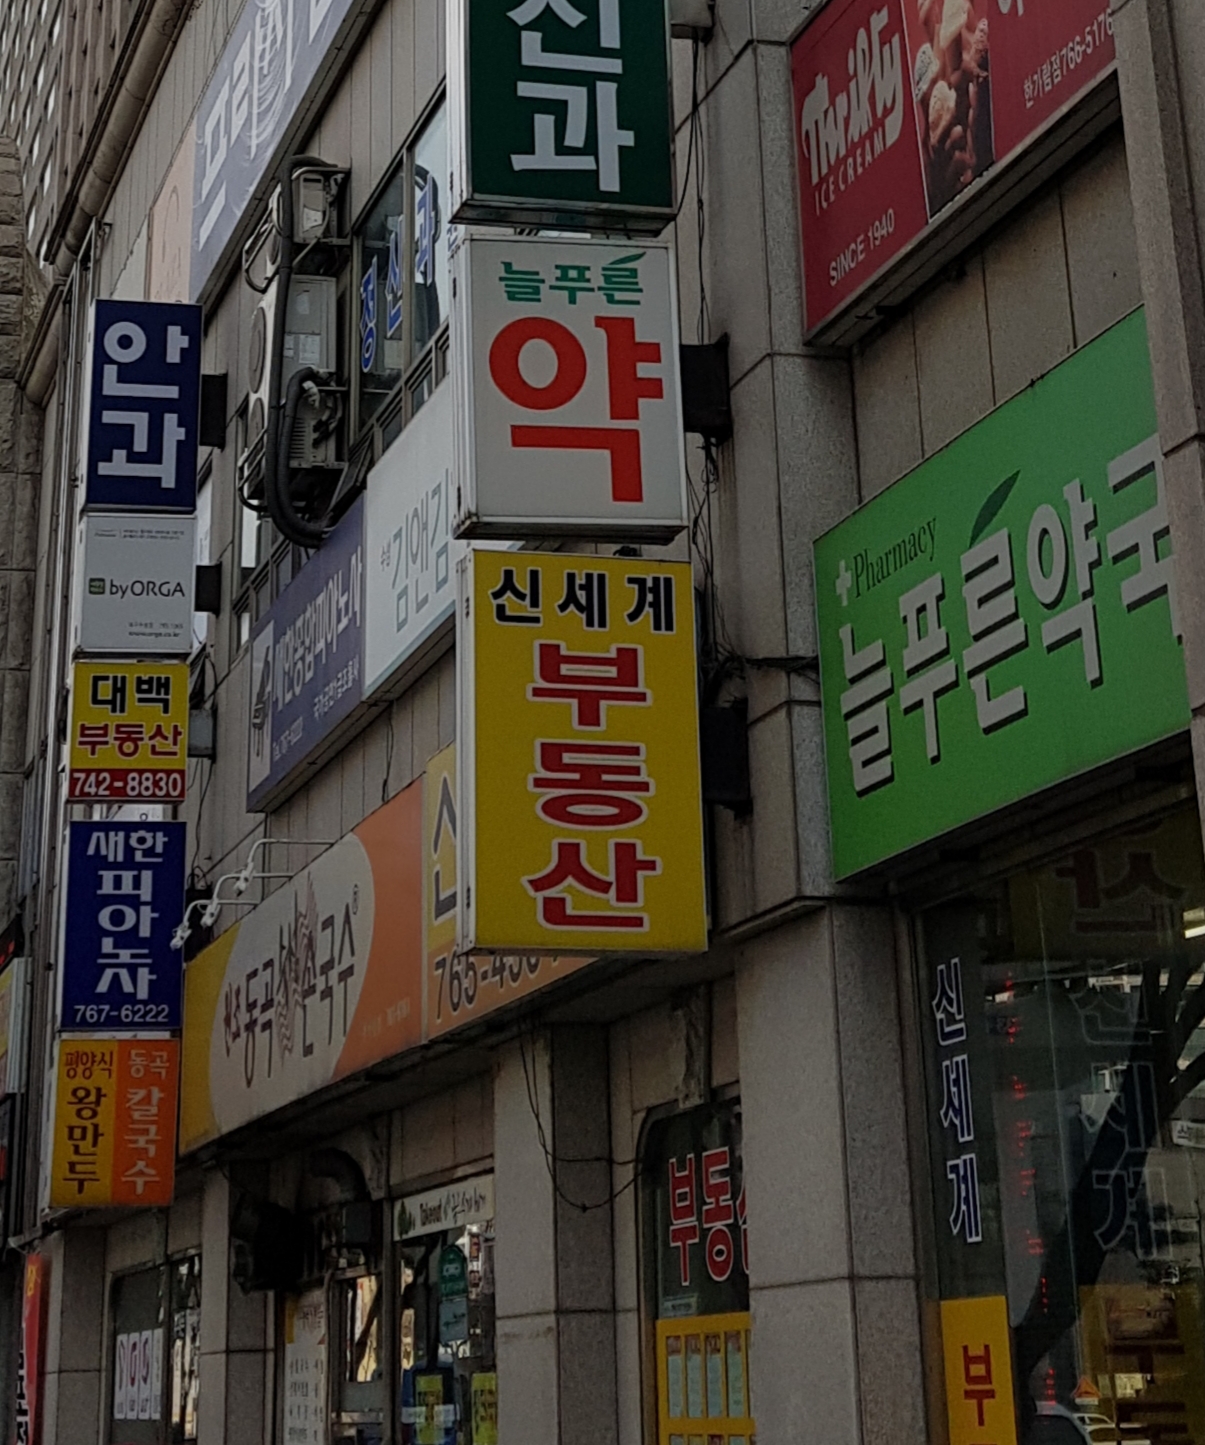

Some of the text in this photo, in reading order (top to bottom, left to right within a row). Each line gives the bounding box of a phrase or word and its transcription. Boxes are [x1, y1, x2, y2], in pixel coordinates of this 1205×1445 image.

[802, 6, 903, 186] Thrifty
[815, 137, 885, 217] ICE CREAM
[499, 252, 646, 306] 늘푸른
[829, 208, 896, 287] SINCE 1940
[97, 321, 190, 489] 안과
[488, 315, 664, 503] 약
[852, 516, 937, 599] Pharmacy
[490, 565, 677, 632] 신세계
[91, 674, 171, 715] 대백
[77, 722, 183, 757] 부동산
[72, 773, 182, 797] 742-8830
[527, 640, 663, 932] 부동산
[87, 830, 168, 863] 새한
[94, 870, 159, 1000] 피아노사
[74, 1005, 169, 1023] 767-6222
[64, 1050, 114, 1079] 평양식
[127, 1050, 170, 1078] 동곡
[931, 957, 982, 1244] 신세계
[62, 1086, 107, 1194] 왕만두
[121, 1086, 164, 1194] 칼국수
[668, 1146, 749, 1287] 부동
